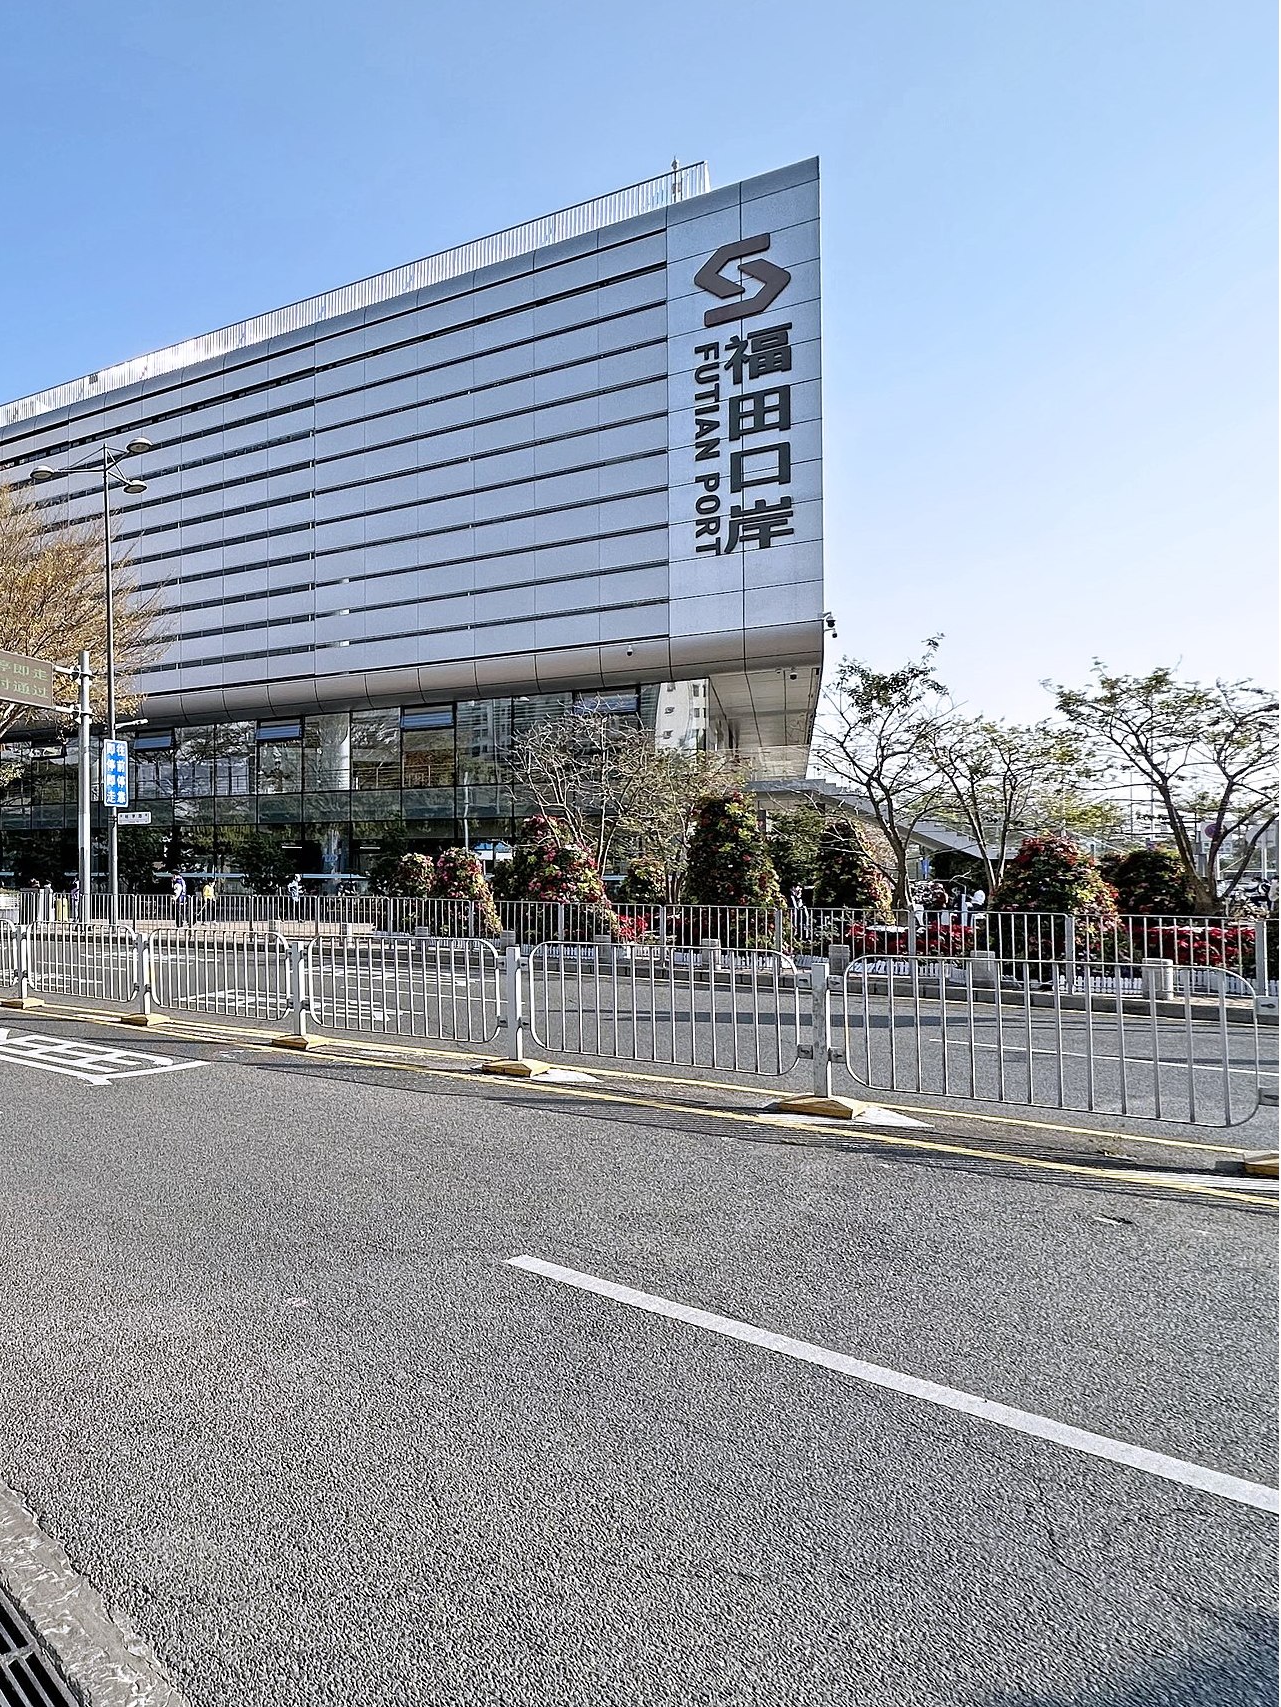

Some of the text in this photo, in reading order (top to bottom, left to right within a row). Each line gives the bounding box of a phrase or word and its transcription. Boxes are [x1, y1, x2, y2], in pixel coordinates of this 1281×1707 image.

[694, 342, 721, 556] FUTIAN PORT
[724, 322, 794, 555] 福田口岸
[106, 742, 116, 803] 即停即走
